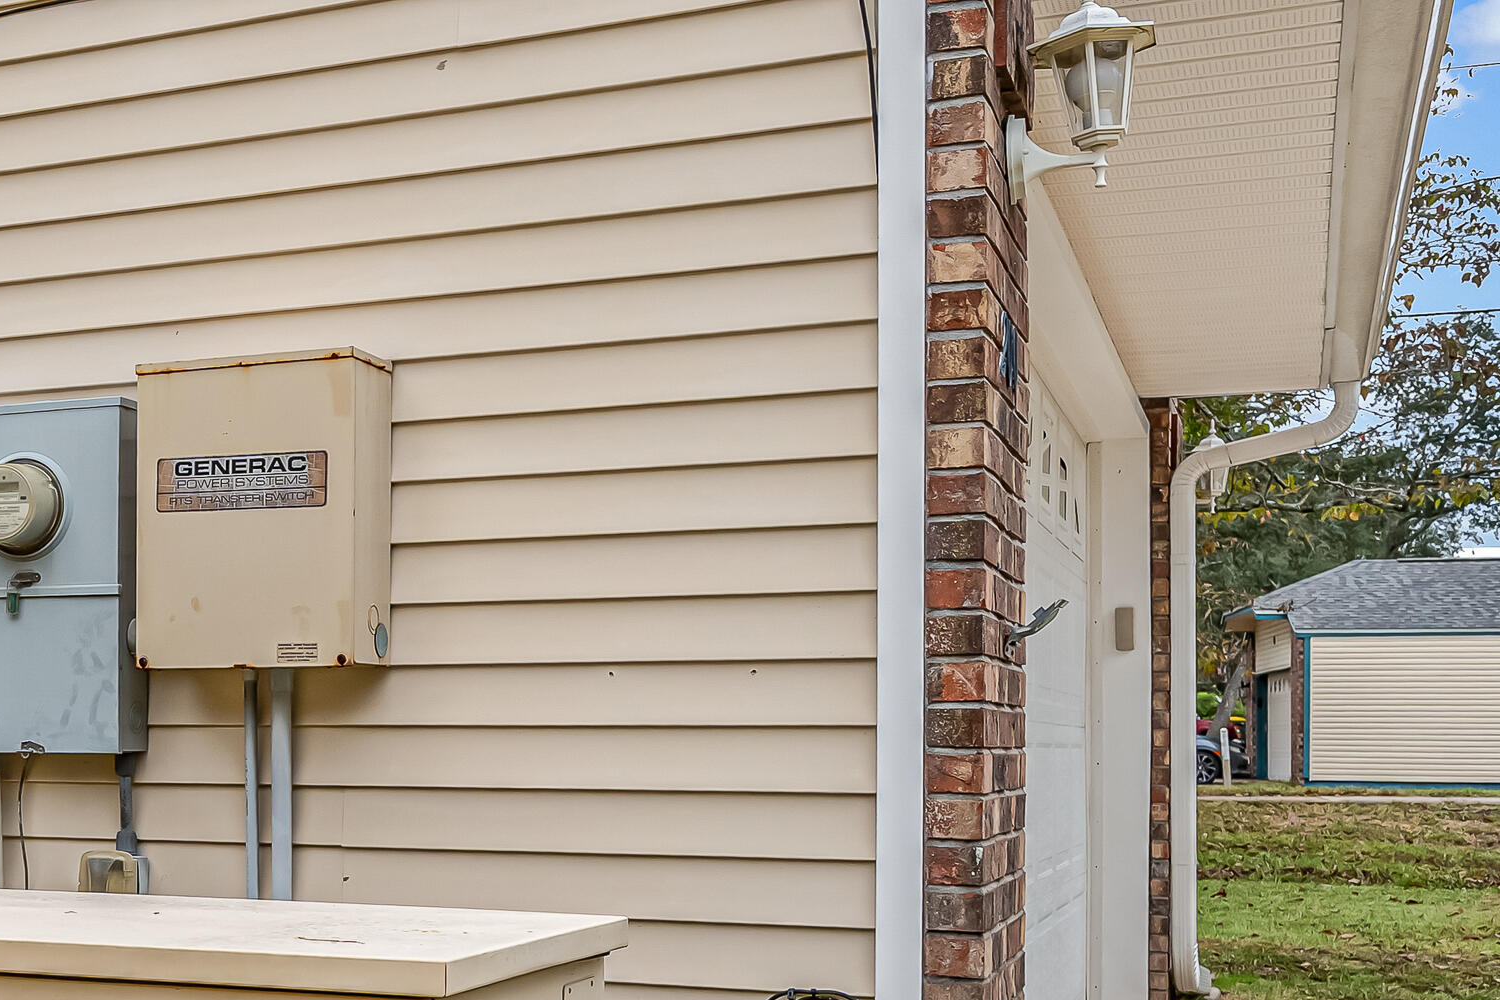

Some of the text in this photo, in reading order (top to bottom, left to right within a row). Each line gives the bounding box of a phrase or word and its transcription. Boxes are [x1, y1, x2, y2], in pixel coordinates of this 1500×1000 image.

[174, 456, 307, 476] GENERAC
[176, 474, 310, 490] POWER SYSTEMS
[197, 493, 262, 504] TRANSFER
[265, 490, 315, 502] SWITCH
